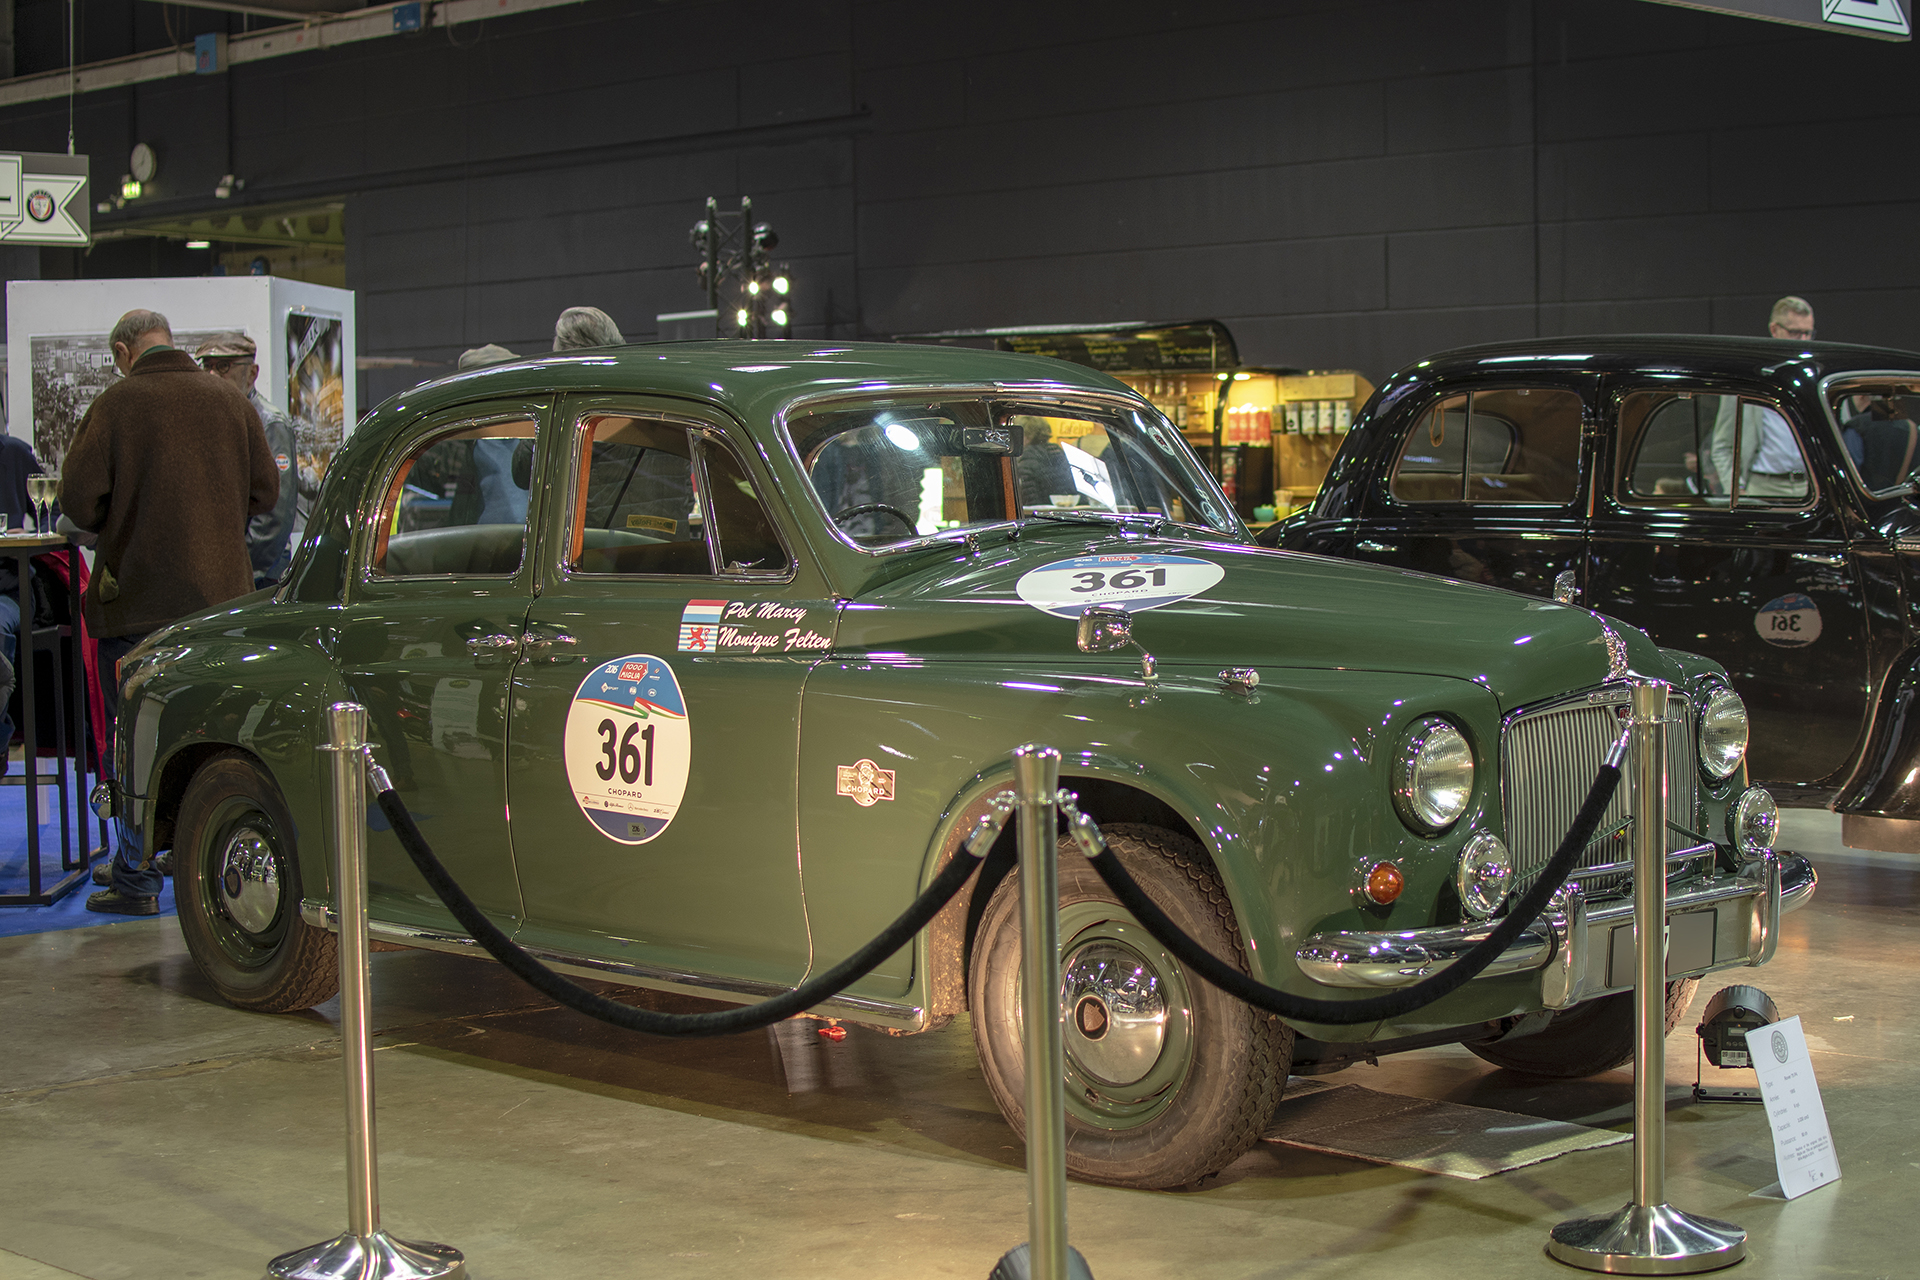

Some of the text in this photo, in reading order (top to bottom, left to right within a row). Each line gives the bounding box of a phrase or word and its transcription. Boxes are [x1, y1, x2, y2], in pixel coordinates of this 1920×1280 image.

[1070, 568, 1166, 593] 361
[1092, 589, 1148, 597] CHOPARD
[724, 601, 808, 625] Pol Marcy
[717, 626, 832, 654] Monique Felten
[620, 671, 641, 680] MIGLIA
[595, 718, 655, 787] 361
[607, 788, 643, 799] CHOPARD
[846, 785, 885, 795] CHOPARD
